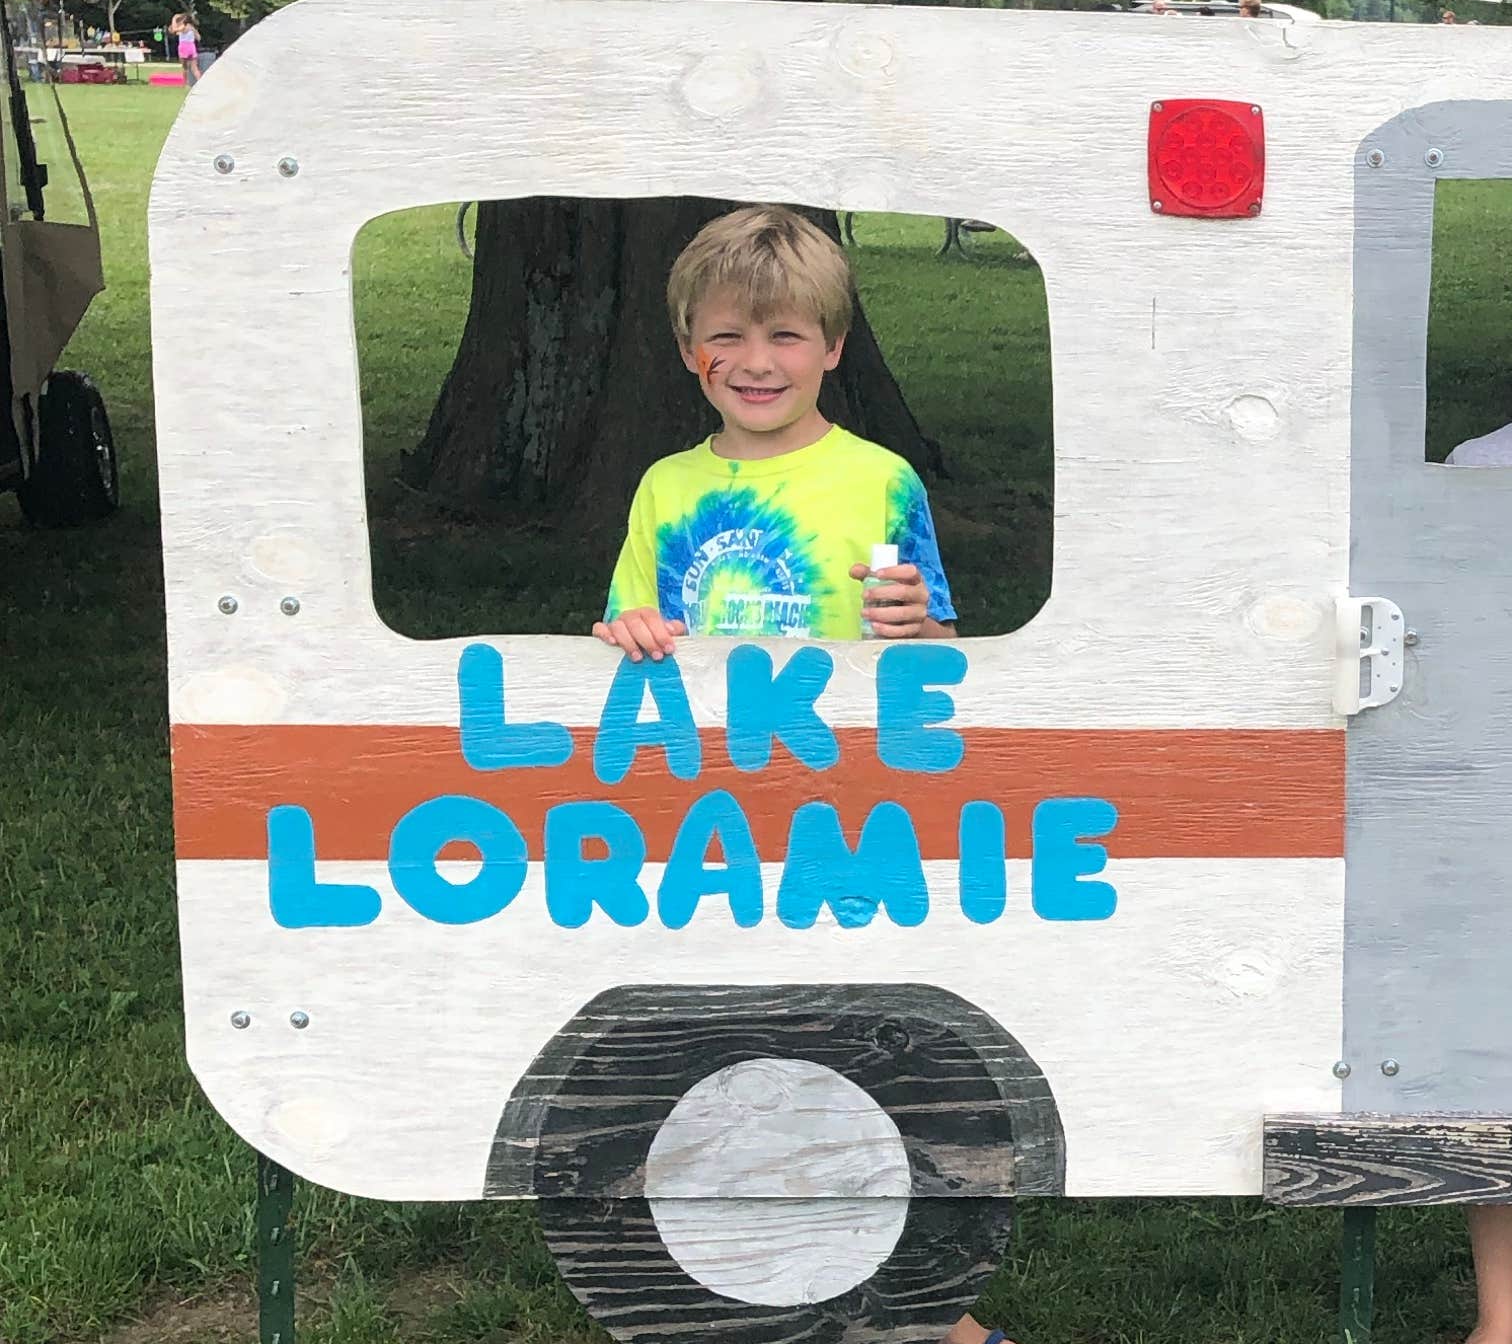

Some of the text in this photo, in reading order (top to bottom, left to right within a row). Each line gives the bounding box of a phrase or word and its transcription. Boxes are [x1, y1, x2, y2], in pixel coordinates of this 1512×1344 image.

[685, 550, 710, 592] SUN
[459, 644, 967, 783] LAKE
[269, 791, 1117, 929] LORAMIE
